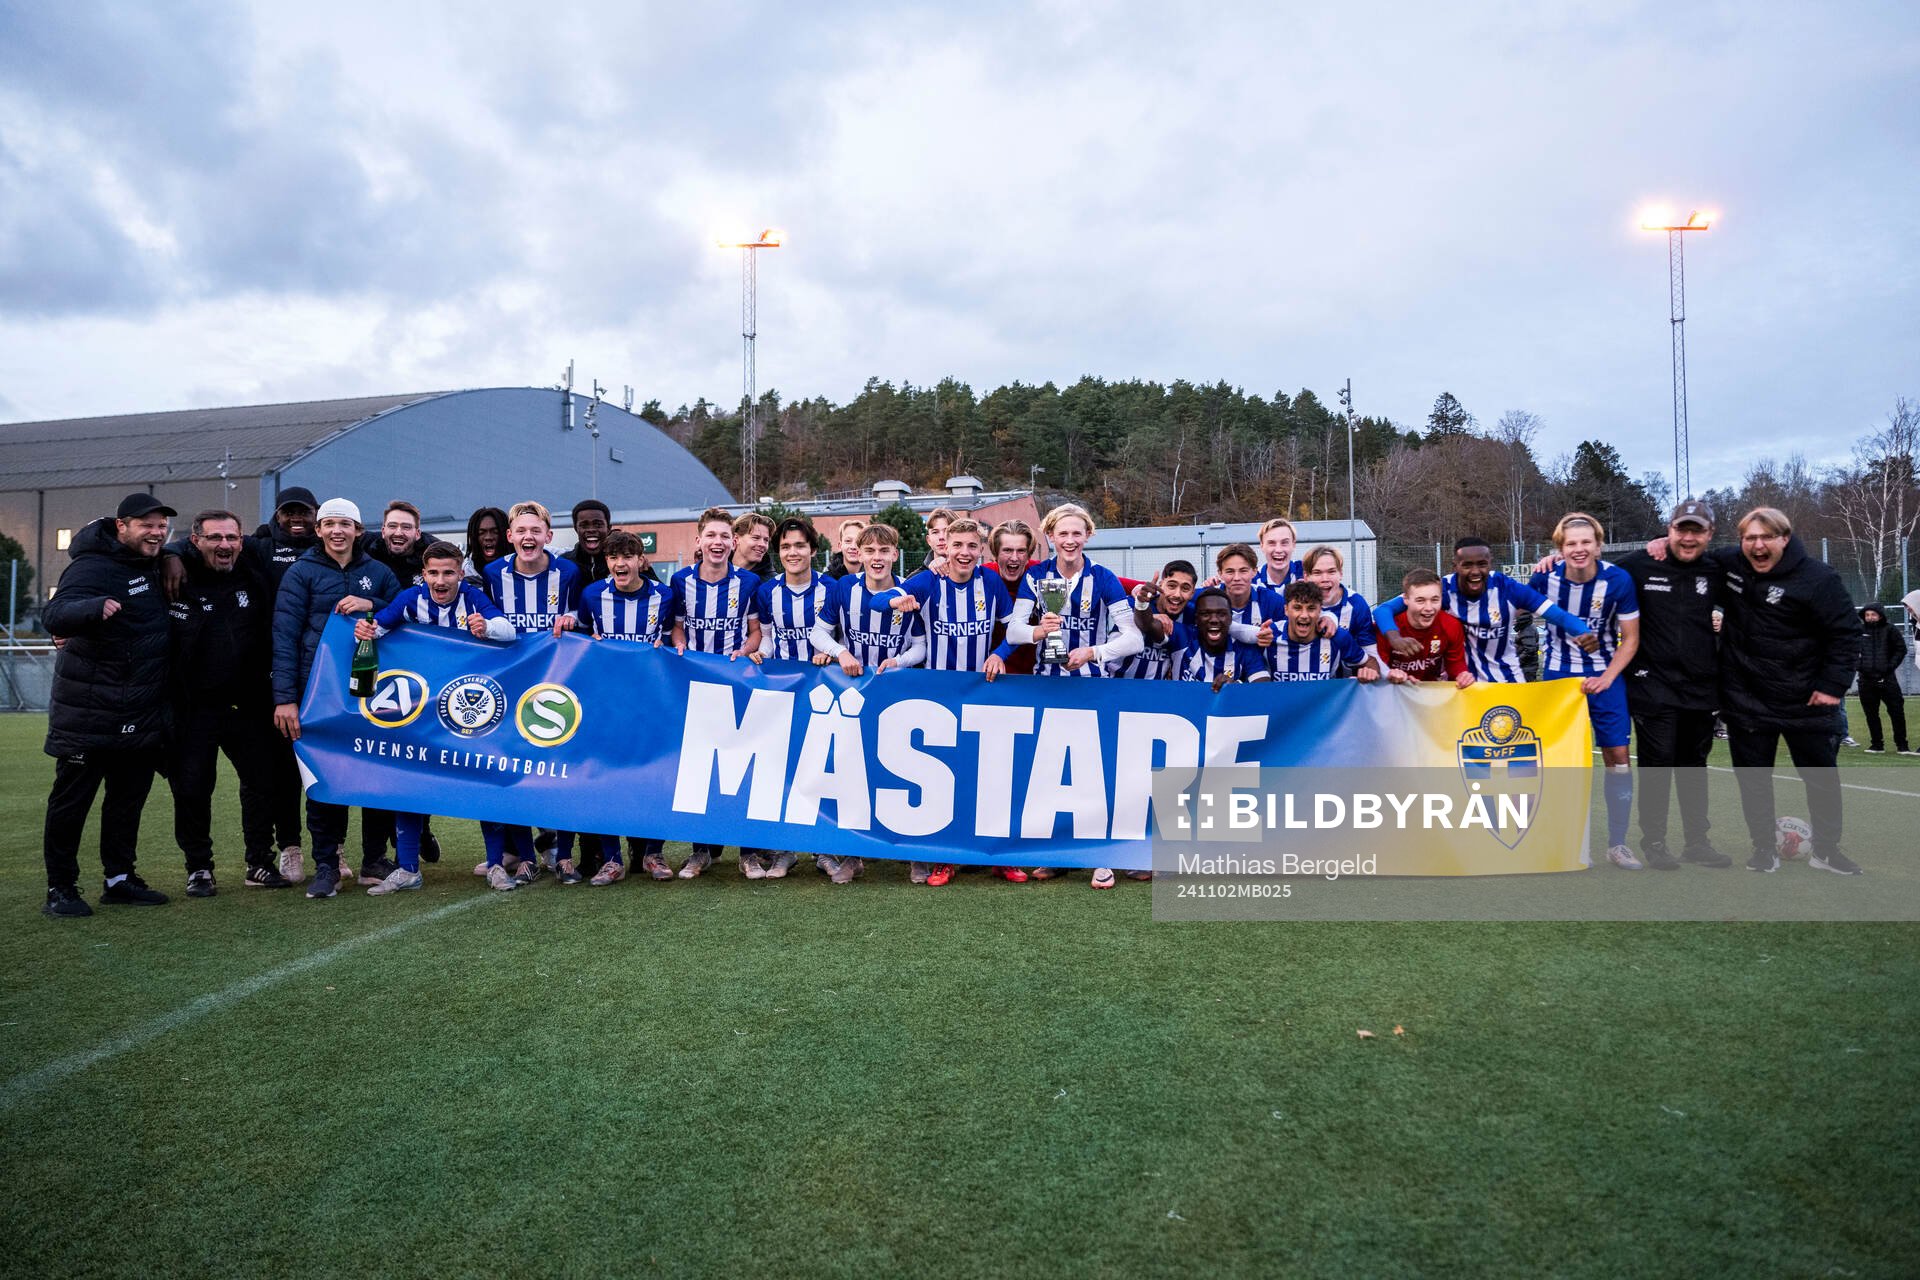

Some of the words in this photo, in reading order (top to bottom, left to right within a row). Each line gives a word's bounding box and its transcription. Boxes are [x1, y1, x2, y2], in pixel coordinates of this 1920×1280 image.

[128, 583, 150, 596] SERNEKE
[504, 613, 561, 628] ERNEK
[684, 616, 741, 631] SERNEKE
[933, 619, 991, 637] SERNEKE
[776, 626, 814, 640] SERNE
[849, 628, 903, 648] SERNEKE
[121, 725, 135, 733] LG
[354, 737, 428, 762] SVENSK
[440, 750, 568, 778] ELITFOTBOLL
[1484, 746, 1516, 758] SvFF
[672, 680, 1269, 842] MÄSTARE
